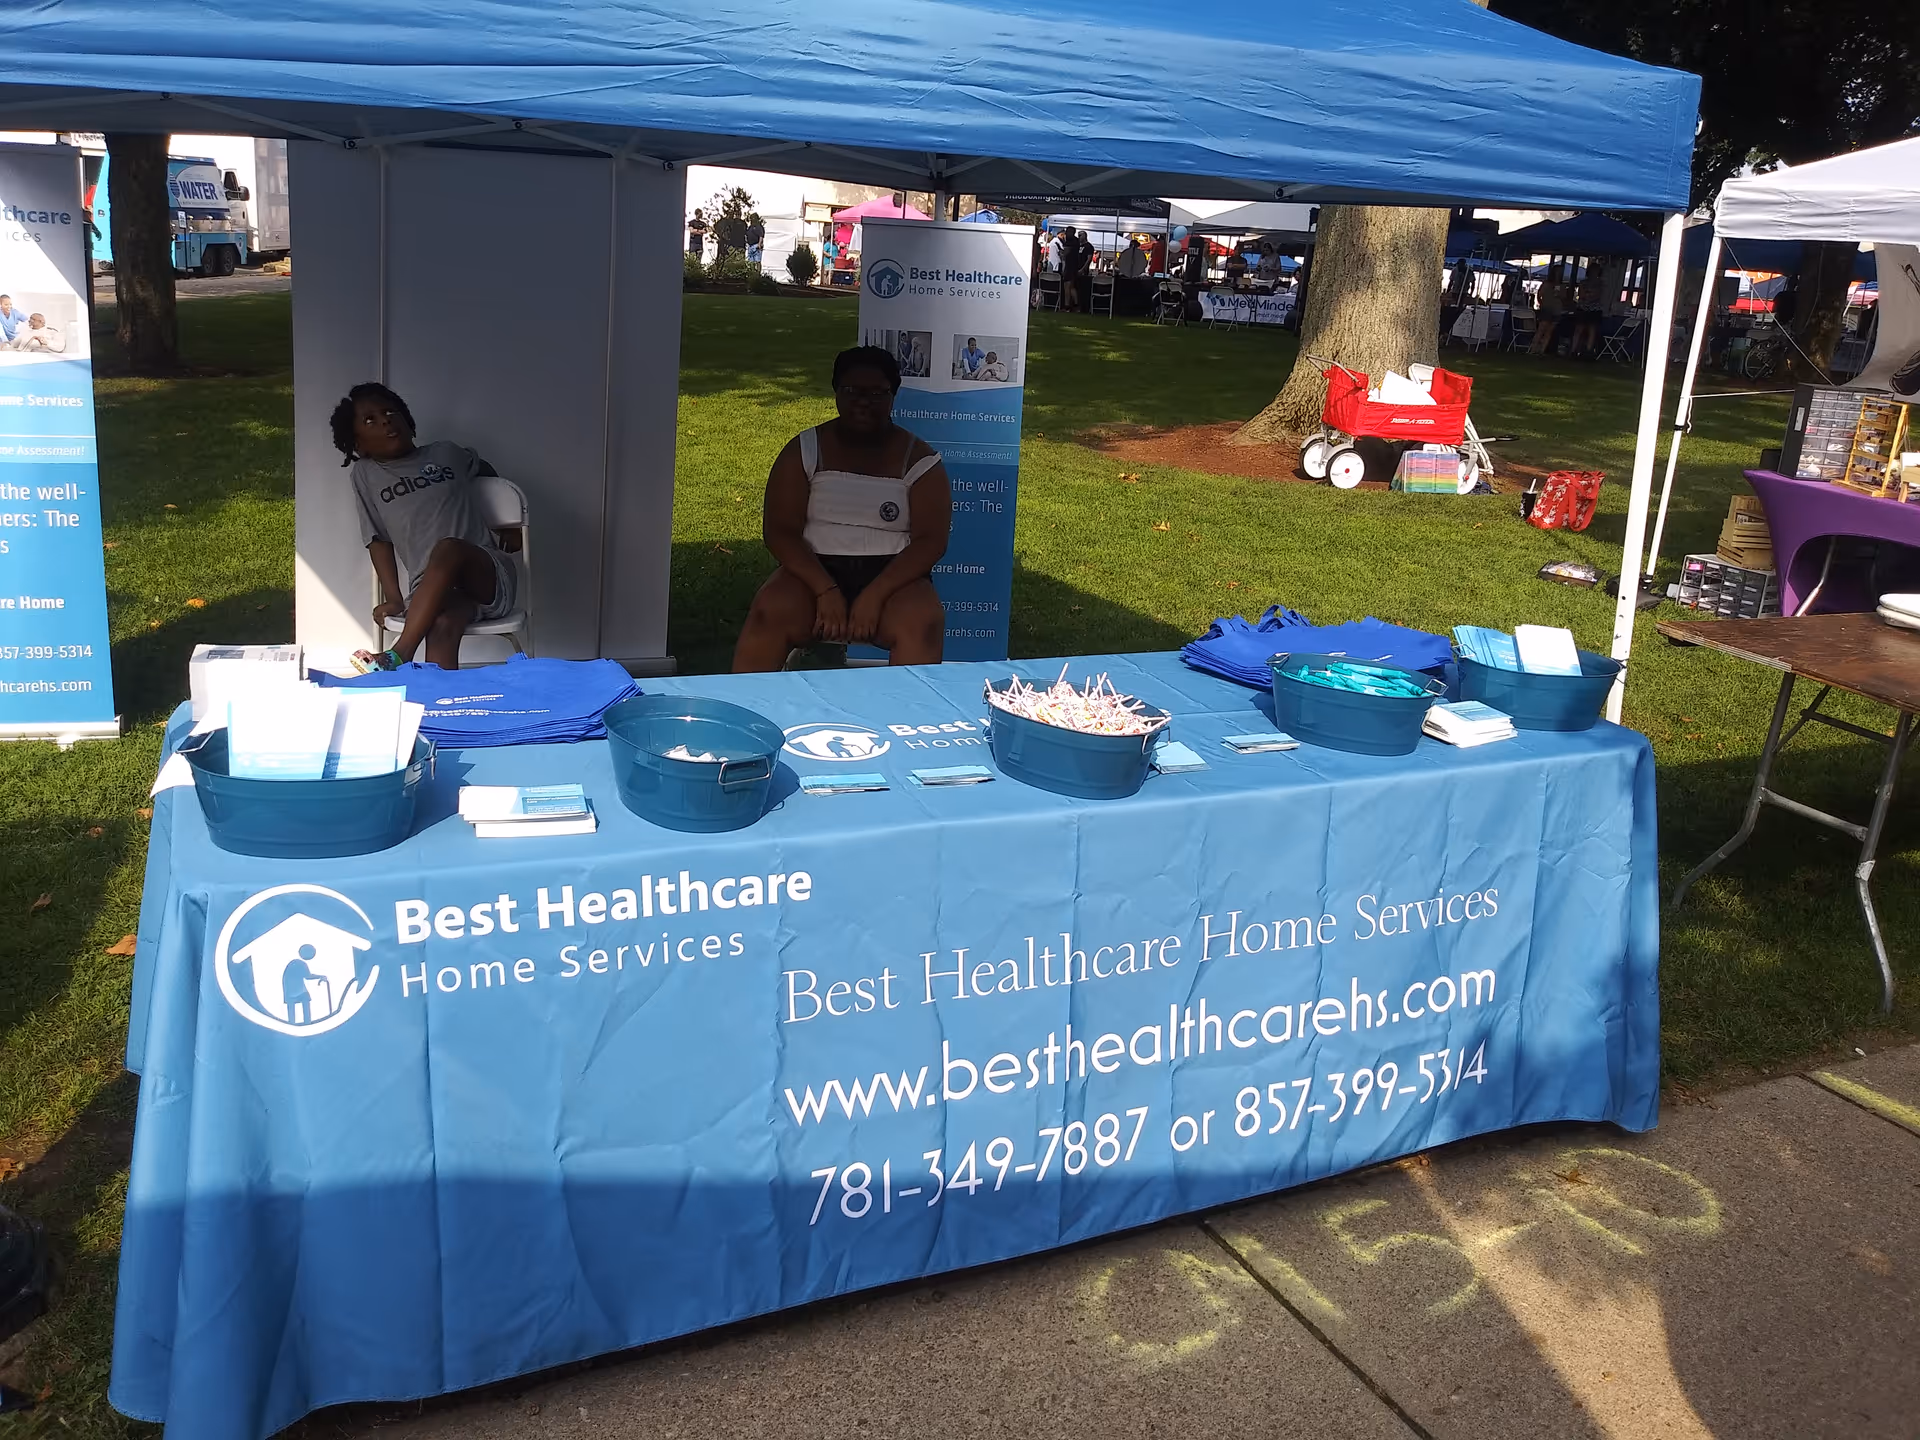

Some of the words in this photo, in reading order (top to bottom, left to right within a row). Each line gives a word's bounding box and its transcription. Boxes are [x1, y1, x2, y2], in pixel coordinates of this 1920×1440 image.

[179, 181, 219, 200] WATER
[3, 205, 72, 225] thcare
[6, 229, 42, 243] ices
[909, 267, 941, 281] Best
[945, 269, 1023, 286] Healthcare
[909, 285, 944, 296] Home
[949, 286, 1001, 299] Services
[27, 393, 84, 407] Services
[900, 409, 948, 420] Healthcare
[951, 411, 976, 421] Home
[979, 412, 1016, 423] Services
[17, 445, 85, 456] Assessment!
[945, 449, 966, 458] Home
[967, 450, 1013, 460] Assessment!
[0, 482, 31, 500] the
[37, 483, 87, 500] well-
[952, 478, 973, 492] the
[977, 480, 1009, 493] well-
[952, 501, 975, 512] ers:
[980, 499, 1003, 513] The
[0, 513, 38, 528] ers:
[44, 509, 80, 527] The
[956, 563, 985, 574] Home
[20, 595, 65, 609] Home
[945, 628, 995, 638] arehs.com
[0, 679, 92, 693] hcarehs.com
[887, 720, 977, 737] Best
[395, 893, 520, 945] Best
[537, 869, 813, 930] Healthcare
[782, 966, 901, 1024] Best
[919, 932, 1181, 1005] Healthcare
[1199, 910, 1337, 963] Home
[1354, 886, 1499, 941] Services
[401, 952, 535, 998] Home
[561, 931, 746, 979] Services
[784, 968, 1496, 1127] www.besthealthcarehs.com
[809, 1106, 1149, 1226] 781-349-7887
[1170, 1110, 1215, 1152] or
[1234, 1038, 1488, 1138] 857-399-5314
